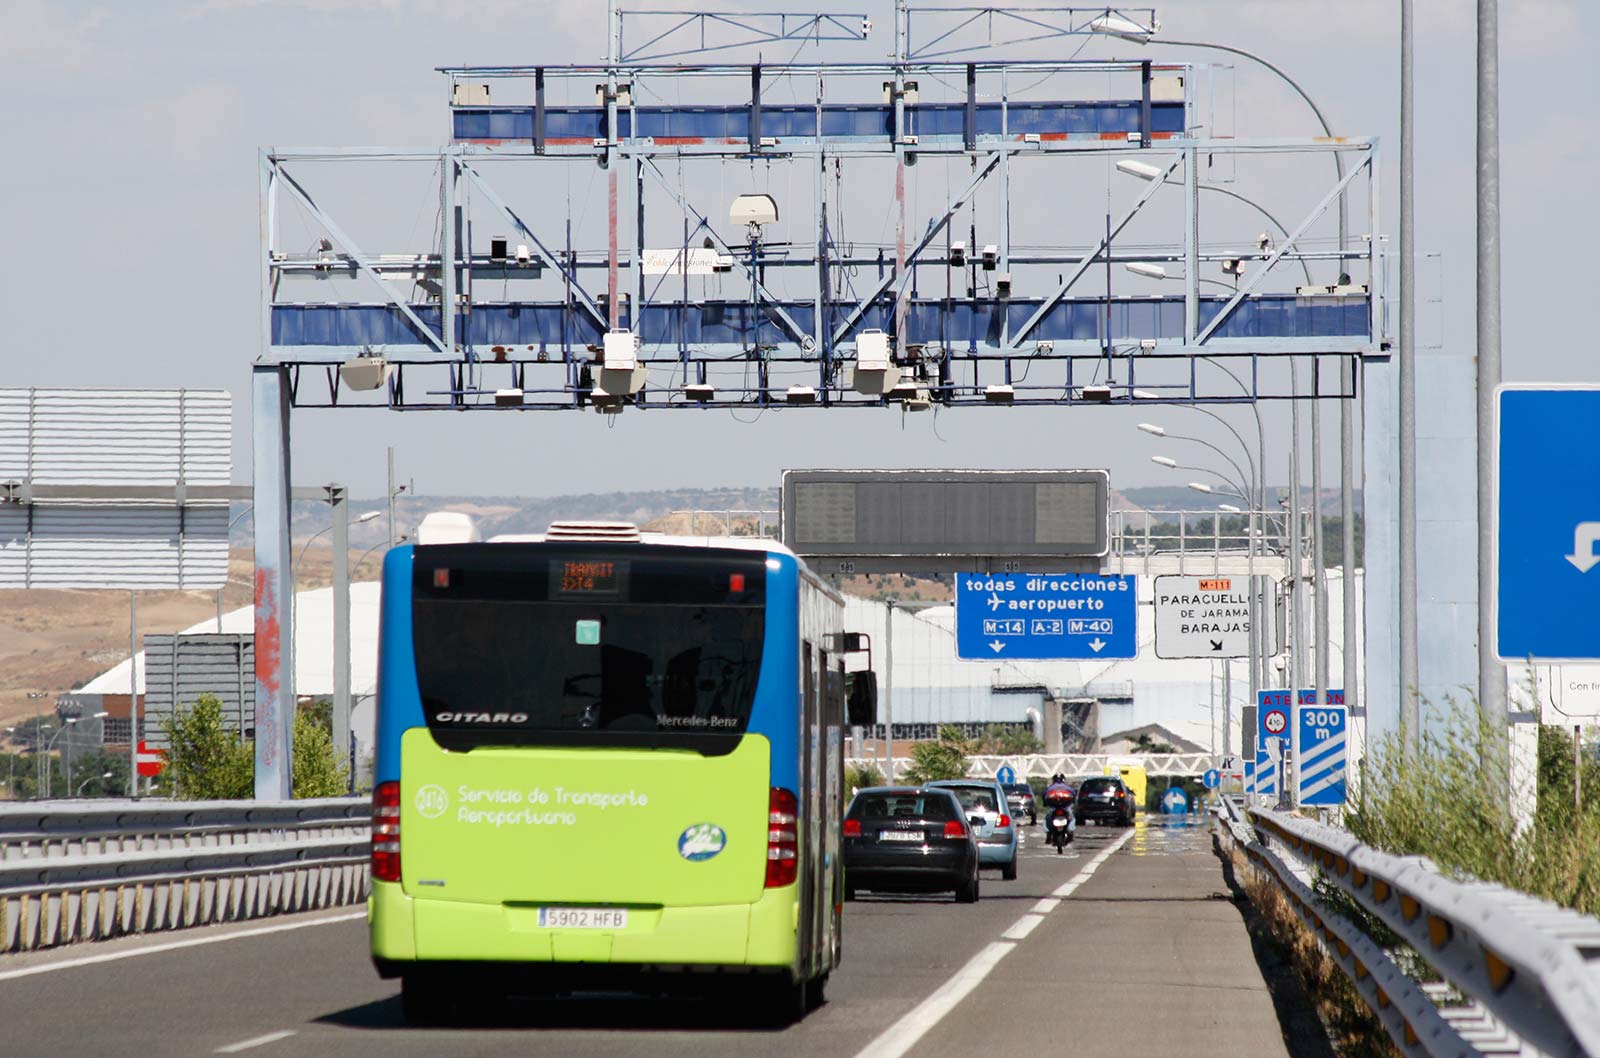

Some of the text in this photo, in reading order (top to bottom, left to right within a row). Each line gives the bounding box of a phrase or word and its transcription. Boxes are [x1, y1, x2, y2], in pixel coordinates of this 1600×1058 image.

[966, 578, 1129, 592] todas direcciones
[1200, 581, 1231, 590] M-111
[1008, 597, 1105, 613] aeropuerto
[1161, 593, 1264, 606] PARACUELLS
[1181, 608, 1249, 619] DE JARAMA
[985, 621, 1023, 633] M-14
[1035, 621, 1062, 633] A-2
[1070, 620, 1111, 632] M-40
[1181, 622, 1251, 634] BARAJAS
[1569, 681, 1589, 691] Con
[436, 712, 529, 724] CITARO
[656, 713, 738, 728] Mercedes-Benz
[1305, 711, 1340, 727] 300
[1315, 728, 1330, 740] m
[457, 785, 649, 810] Servicio de Transporte
[457, 806, 577, 828] Aeroportuario
[548, 910, 623, 928] 5902 HFB
